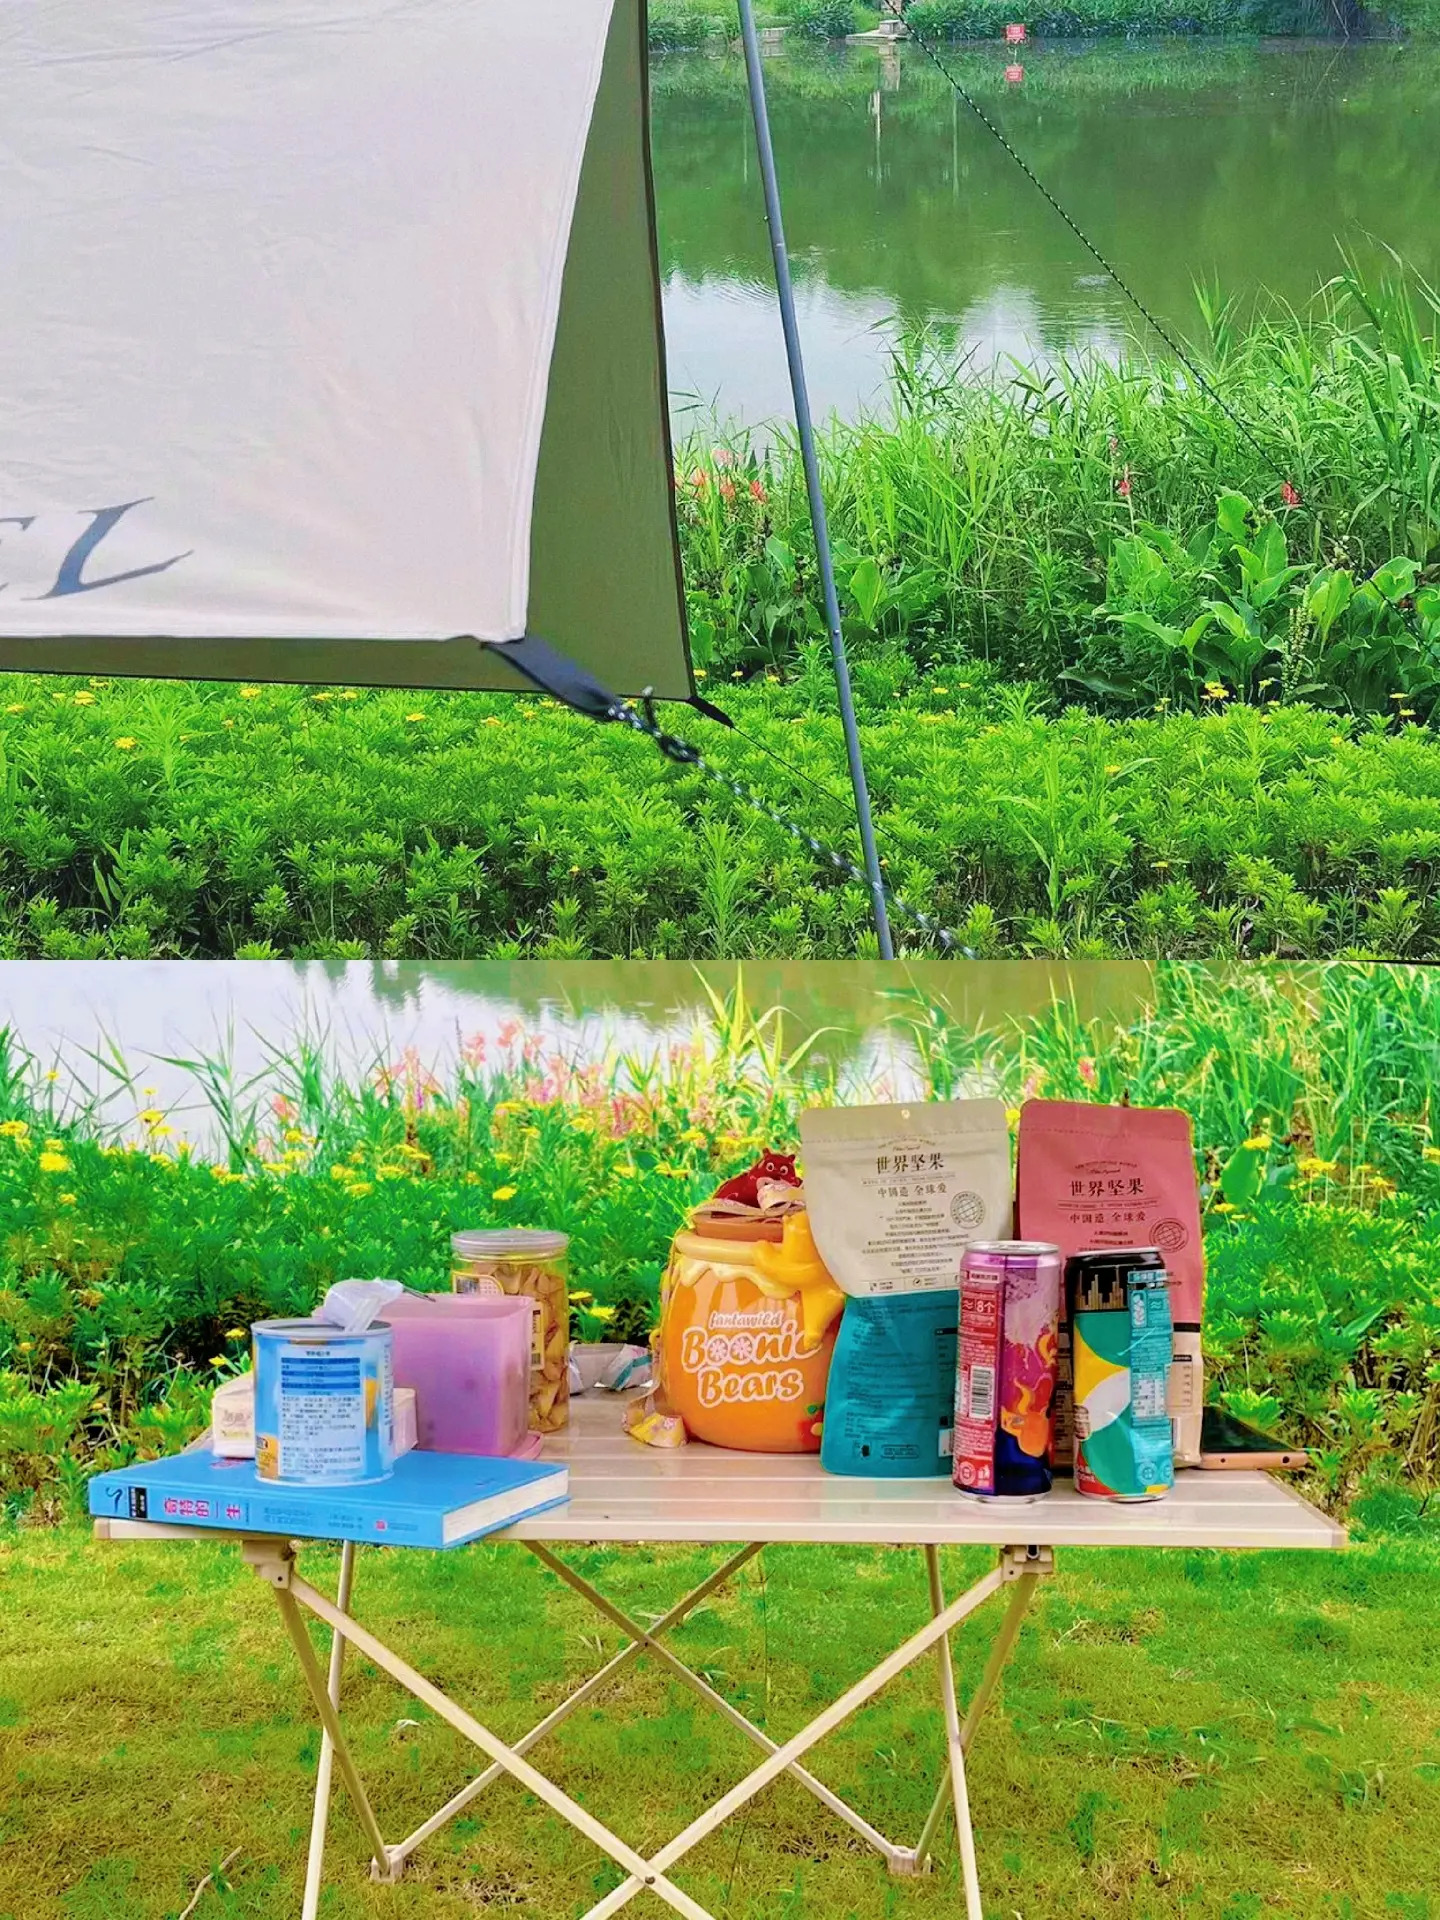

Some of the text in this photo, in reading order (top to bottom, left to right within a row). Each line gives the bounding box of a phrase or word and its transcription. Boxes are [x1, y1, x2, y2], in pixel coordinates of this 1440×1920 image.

[0, 496, 194, 601] L
[876, 1152, 945, 1175] 世界坚果
[877, 1182, 948, 1199] 中国造 全球爱
[1069, 1177, 1144, 1197] 世界坚果
[1069, 1210, 1147, 1224] 中国造 全球爱
[697, 1366, 804, 1408] Bears
